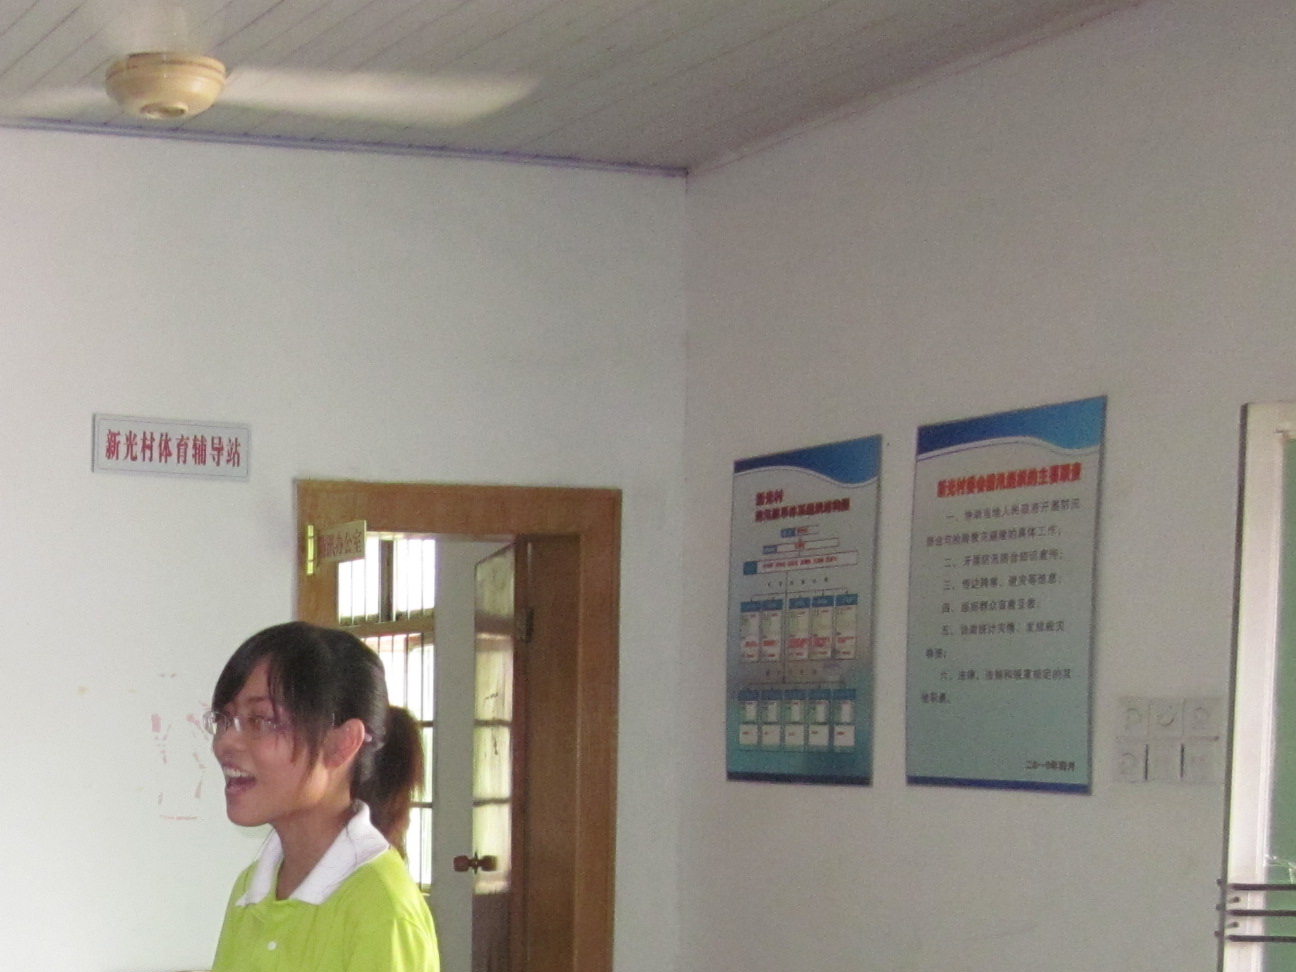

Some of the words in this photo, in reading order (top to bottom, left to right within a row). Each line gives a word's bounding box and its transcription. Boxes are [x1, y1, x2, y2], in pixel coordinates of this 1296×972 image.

[105, 428, 241, 468] 新光村体育辅导站
